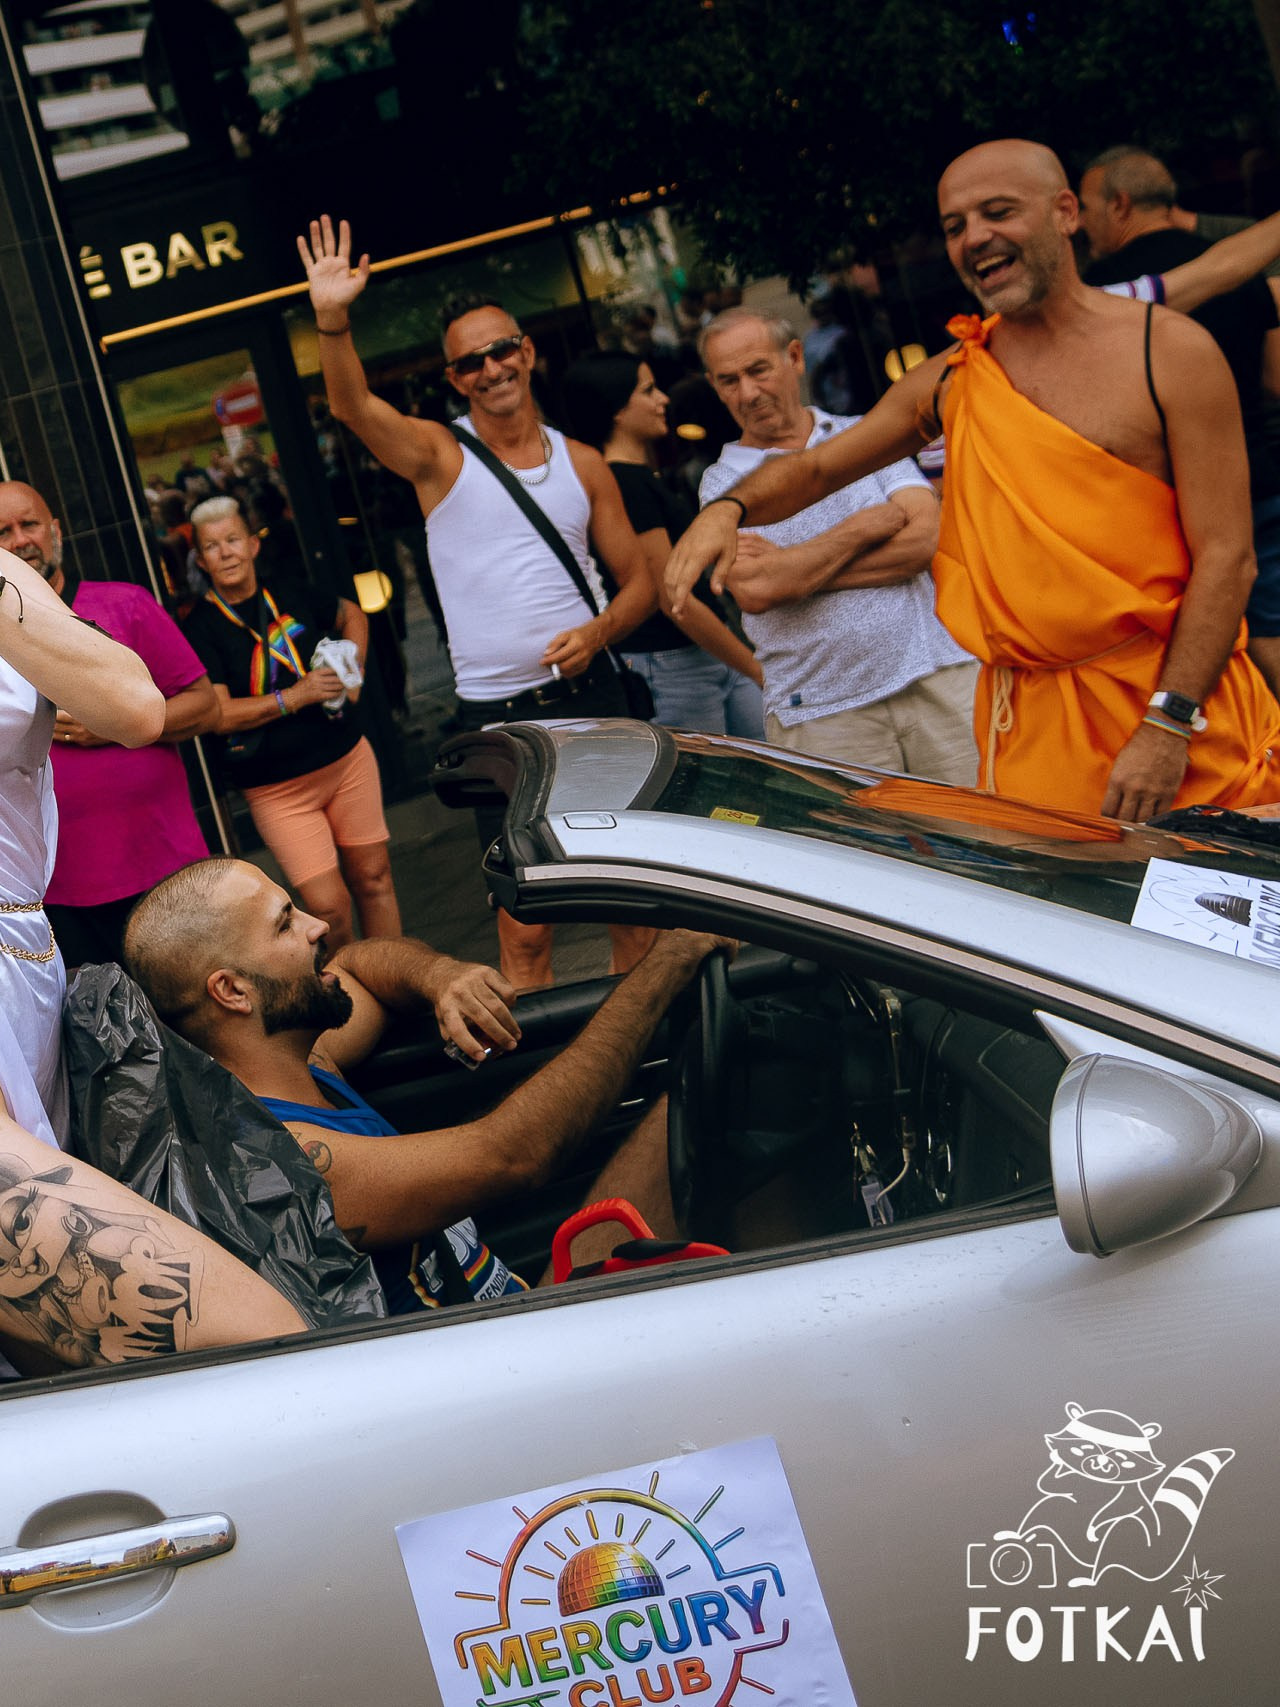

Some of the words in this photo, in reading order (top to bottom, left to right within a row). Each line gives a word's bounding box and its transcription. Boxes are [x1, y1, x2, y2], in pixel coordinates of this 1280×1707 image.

[120, 220, 245, 290] BAR
[470, 1579, 767, 1696] MERCURY
[568, 1656, 712, 1707] CLUB
